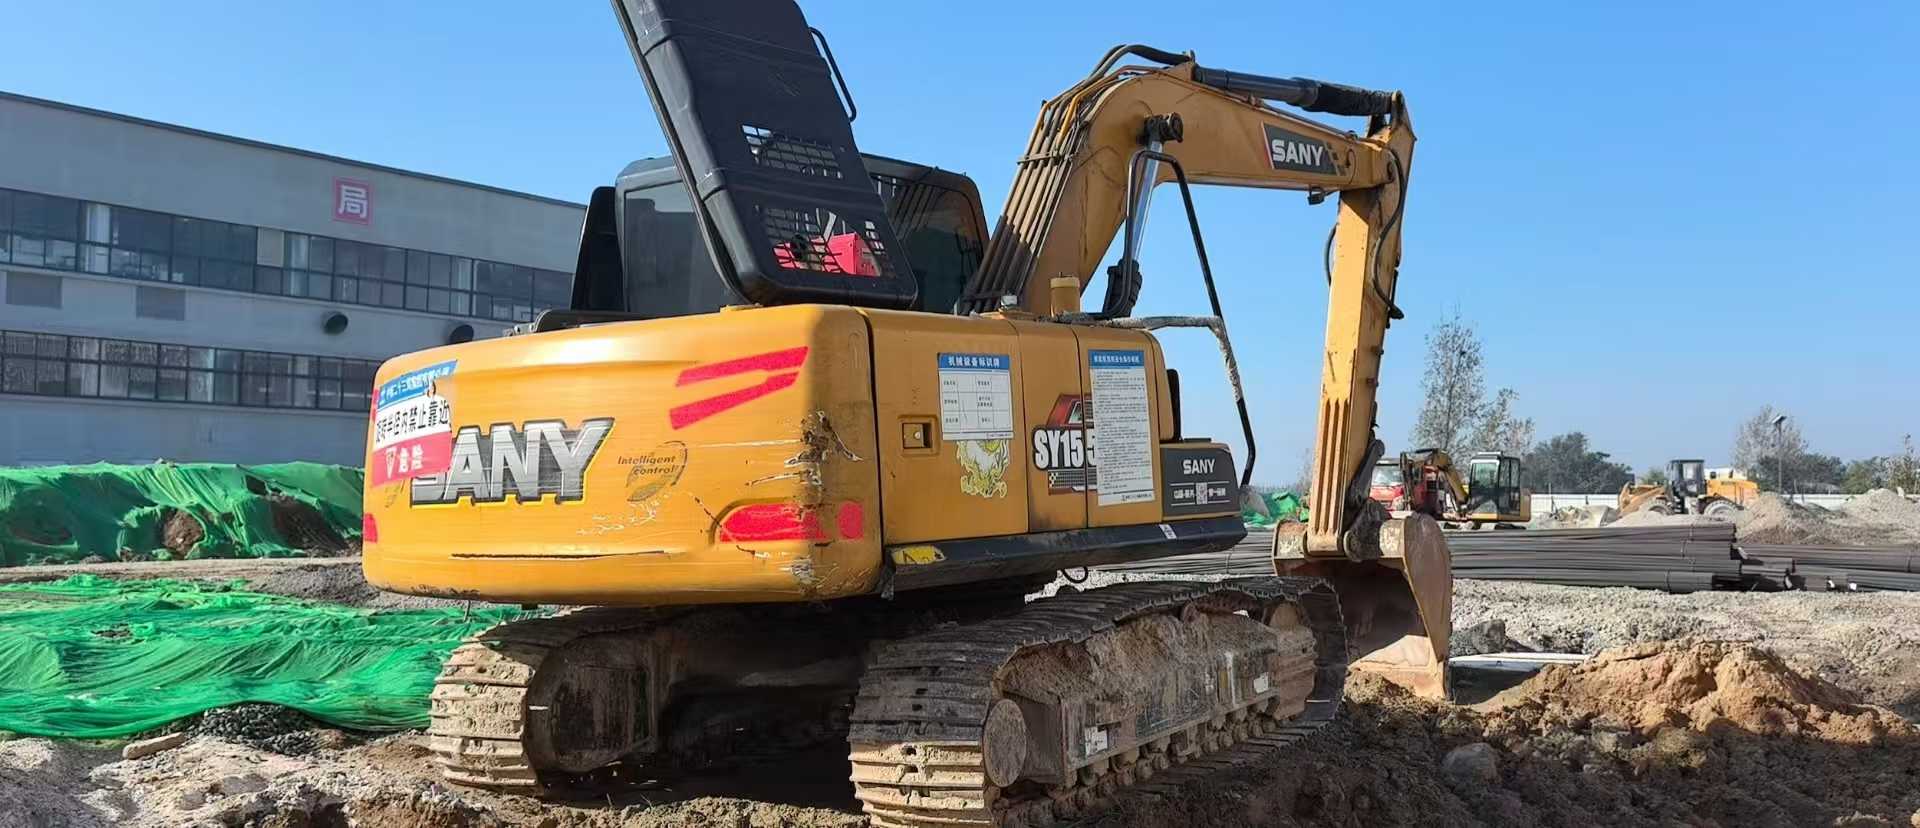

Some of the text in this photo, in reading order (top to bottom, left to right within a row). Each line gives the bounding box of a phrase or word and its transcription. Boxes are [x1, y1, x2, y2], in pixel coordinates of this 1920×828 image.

[1272, 139, 1323, 166] SANY
[339, 184, 368, 218] 局
[399, 445, 423, 473] 危险
[617, 455, 676, 465] Intelligent
[1183, 459, 1215, 475] SANY
